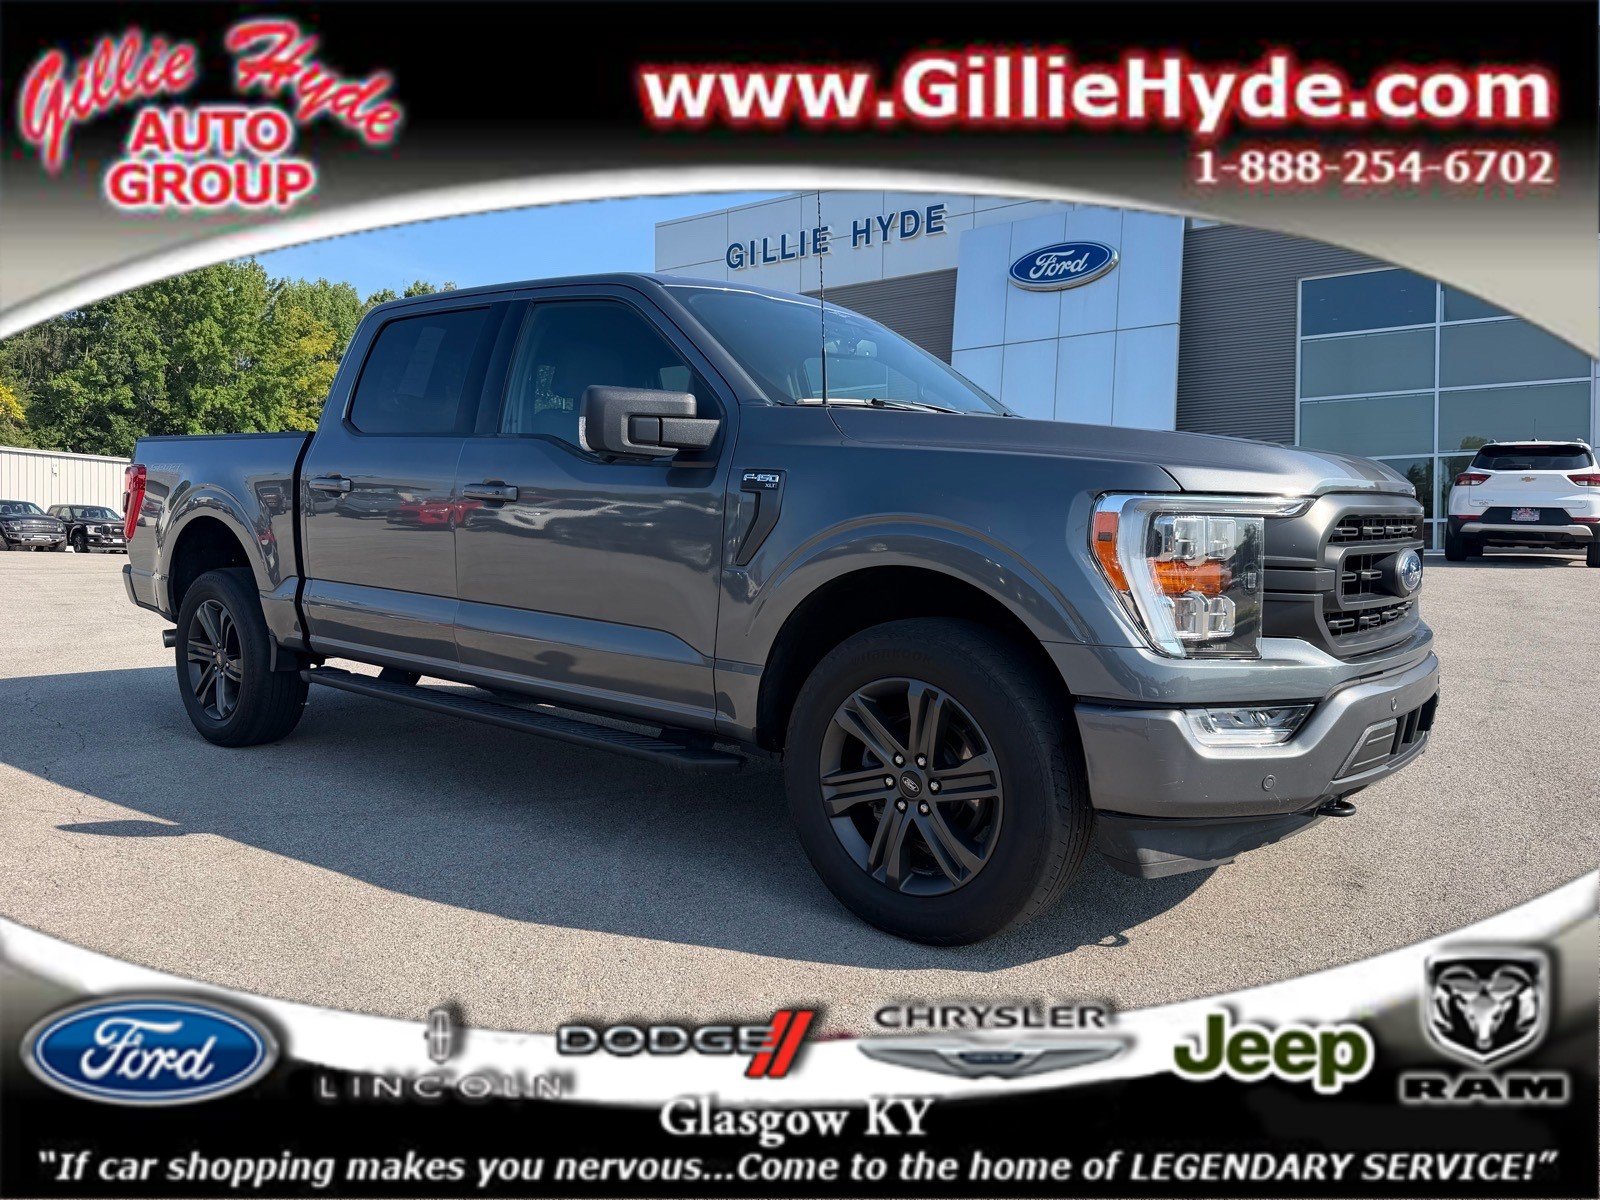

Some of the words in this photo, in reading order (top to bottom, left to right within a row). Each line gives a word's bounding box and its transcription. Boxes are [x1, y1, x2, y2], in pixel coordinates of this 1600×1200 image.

[725, 225, 830, 270] GILLIE
[851, 203, 948, 248] HYDE
[1029, 249, 1091, 279] Ford
[742, 473, 780, 483] F-150
